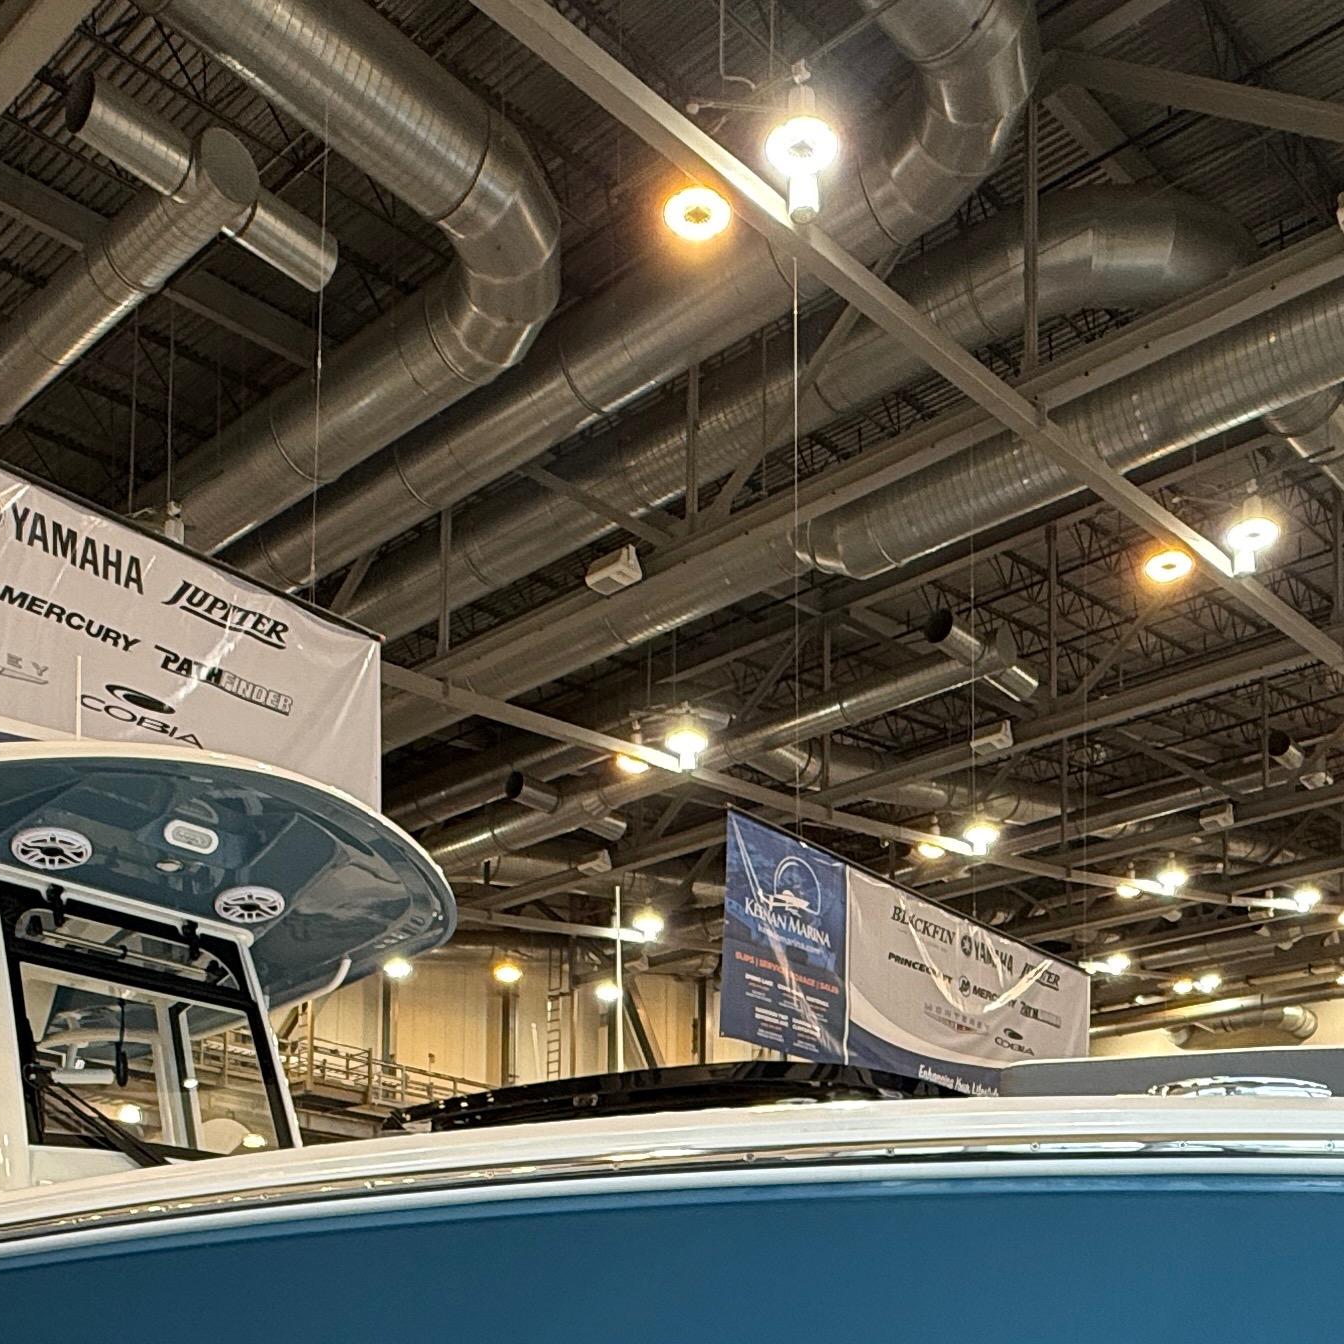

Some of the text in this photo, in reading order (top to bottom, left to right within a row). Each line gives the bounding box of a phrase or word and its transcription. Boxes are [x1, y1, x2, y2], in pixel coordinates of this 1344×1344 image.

[11, 503, 144, 595] YAMAHA
[160, 579, 290, 645] JUPITER
[154, 644, 294, 717] PATHFINDER
[80, 694, 204, 750] COBIA
[788, 915, 831, 949] MARINA
